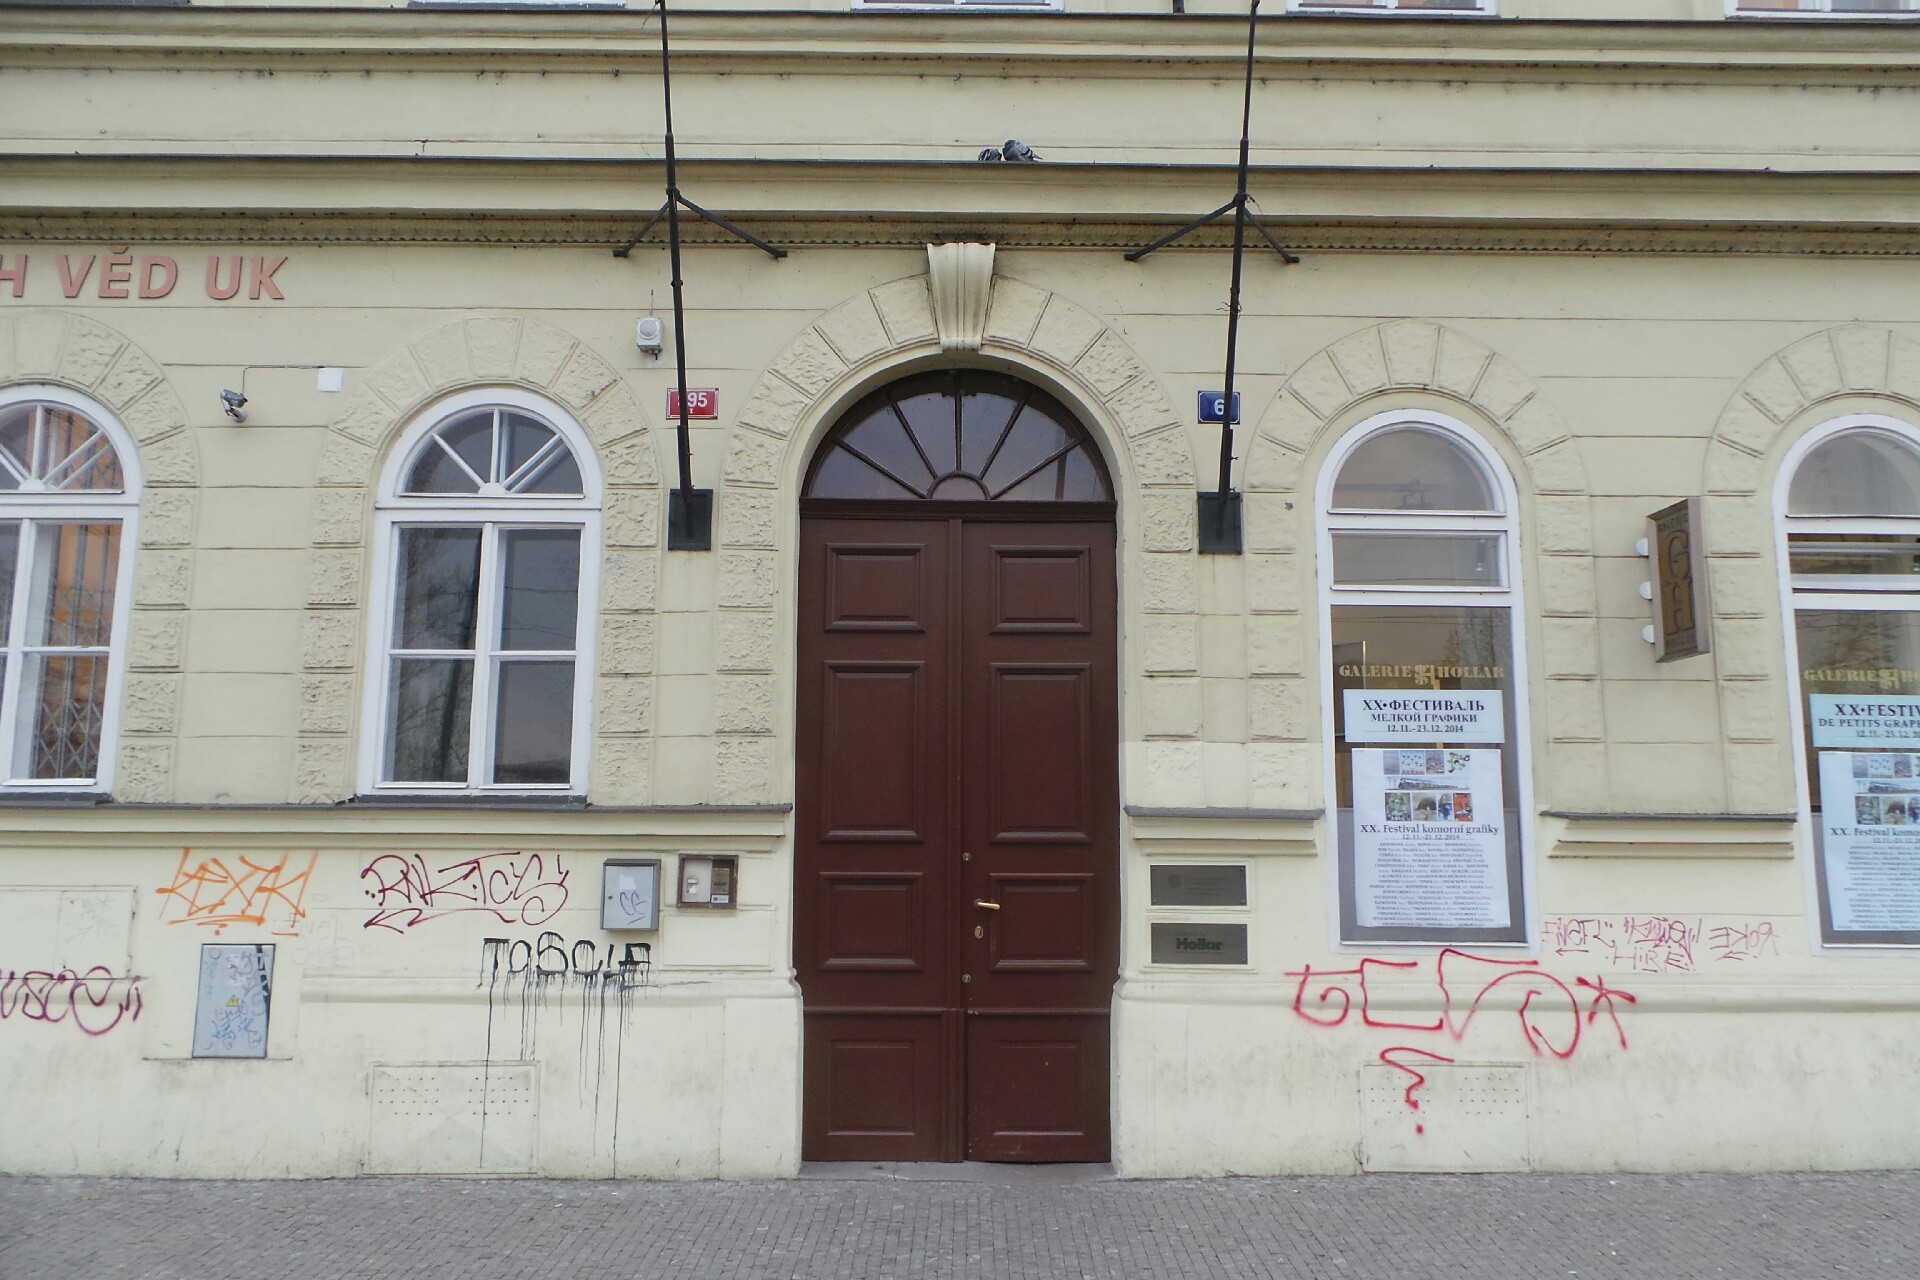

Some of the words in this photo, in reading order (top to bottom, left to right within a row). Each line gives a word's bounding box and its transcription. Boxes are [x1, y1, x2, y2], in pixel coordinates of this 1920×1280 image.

[55, 245, 179, 299] VĚD
[205, 256, 289, 300] UK
[677, 392, 708, 408] 95
[1339, 664, 1412, 678] GALERIE
[1437, 665, 1505, 679] HOLLAR
[1804, 669, 1878, 682] GALERIE
[1370, 712, 1421, 723] МЕЛКОЙ
[1424, 713, 1478, 723] ГРАФИКИ
[1818, 718, 1835, 727] DE
[1839, 719, 1881, 728] PETITS
[1444, 724, 1464, 732] 2014
[1360, 824, 1380, 833] XX.
[1383, 823, 1420, 833] Festival
[1422, 823, 1464, 833] komorní
[1465, 824, 1499, 835] grafiky
[1854, 827, 1890, 836] Festival
[1175, 937, 1224, 951] Hollar
